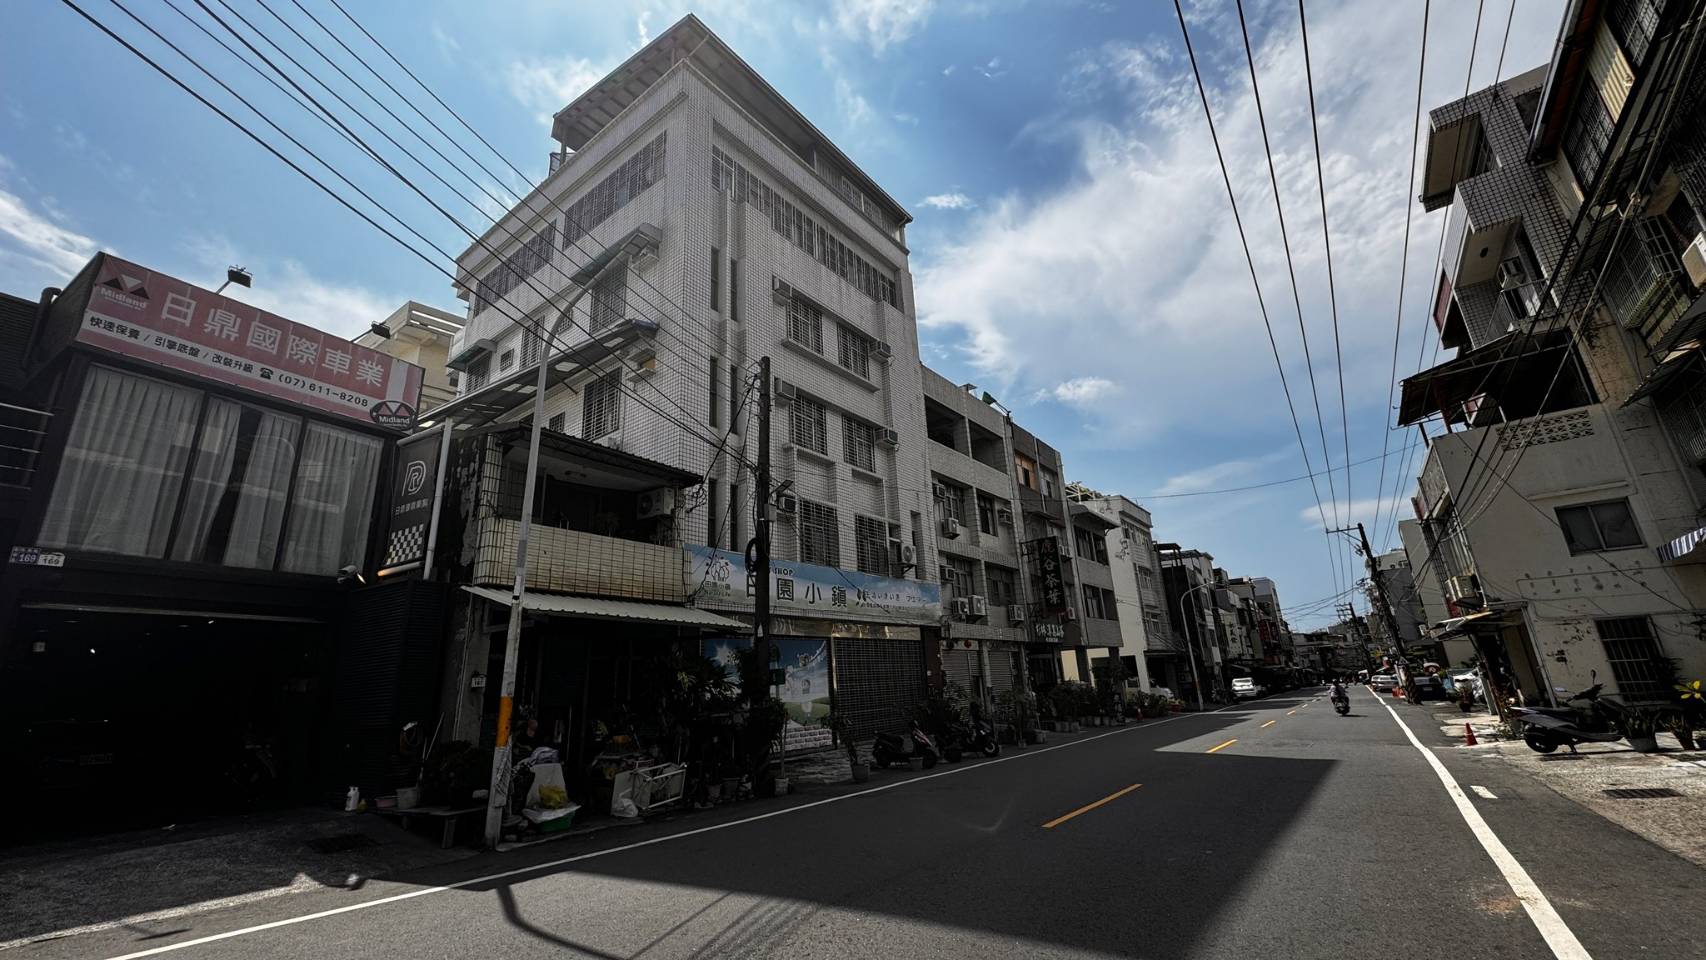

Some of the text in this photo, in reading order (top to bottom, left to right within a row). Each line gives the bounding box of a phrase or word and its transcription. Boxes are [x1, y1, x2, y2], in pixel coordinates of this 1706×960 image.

[100, 286, 147, 308] Midland
[89, 315, 140, 341] 快速保養
[154, 335, 200, 359] 引擎底盤
[211, 353, 255, 374] 改裝升級
[161, 292, 384, 387] 日鼎國際車業
[379, 415, 410, 425] Midland
[19, 553, 37, 563] 169
